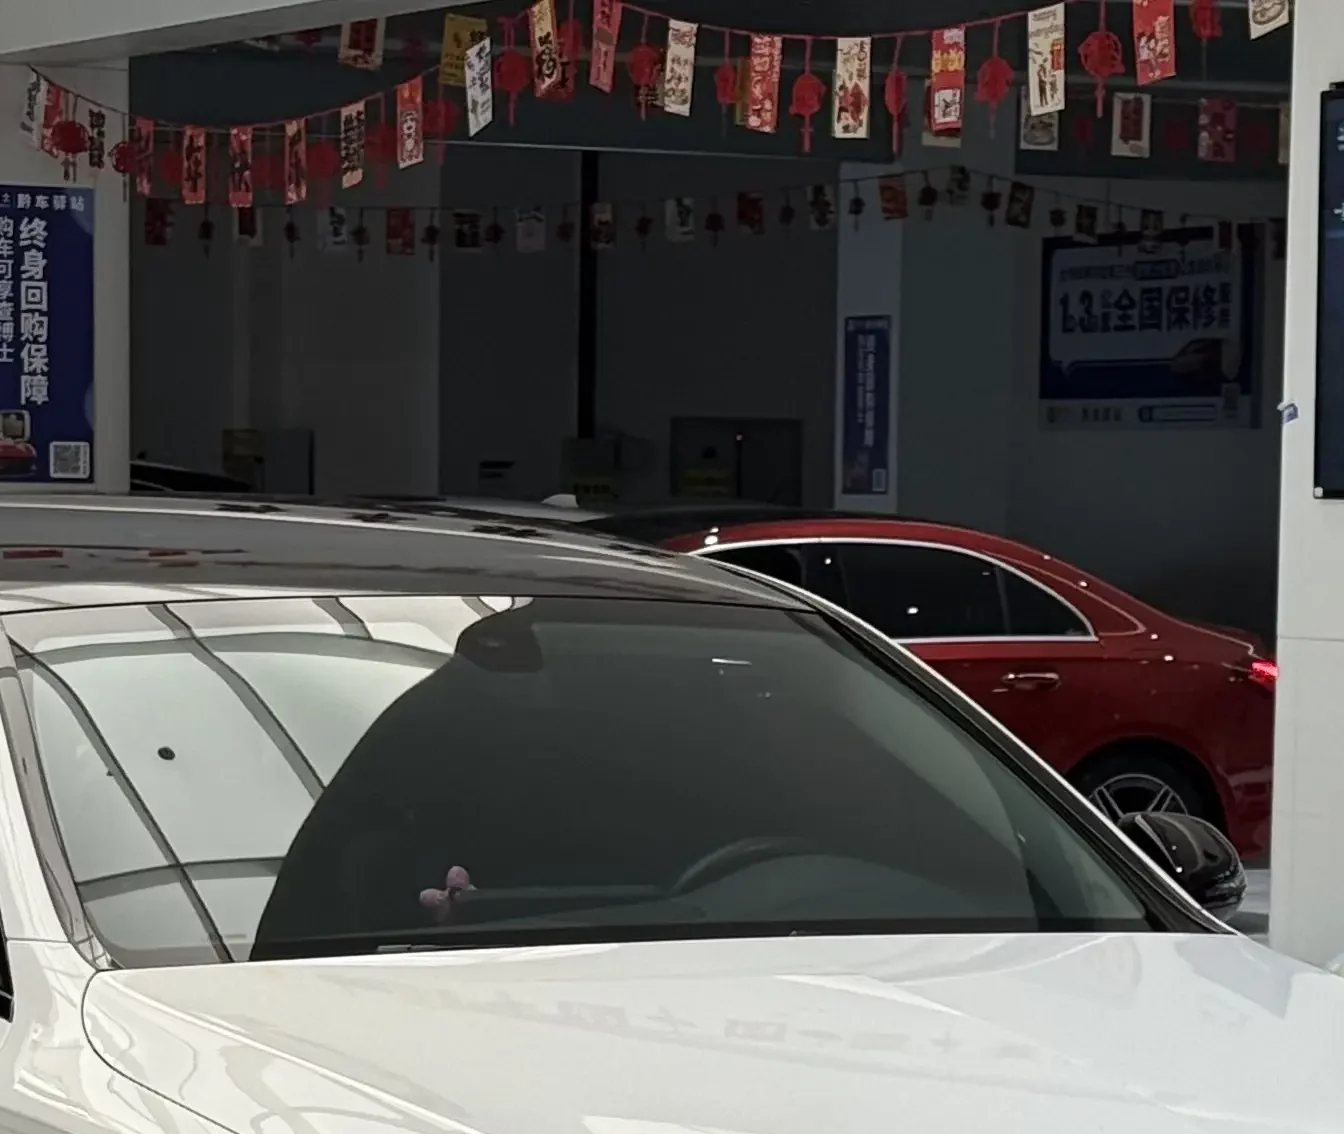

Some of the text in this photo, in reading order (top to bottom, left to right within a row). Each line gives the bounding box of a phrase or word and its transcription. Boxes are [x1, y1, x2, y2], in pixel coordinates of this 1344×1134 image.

[19, 216, 50, 405] 终身回购保障
